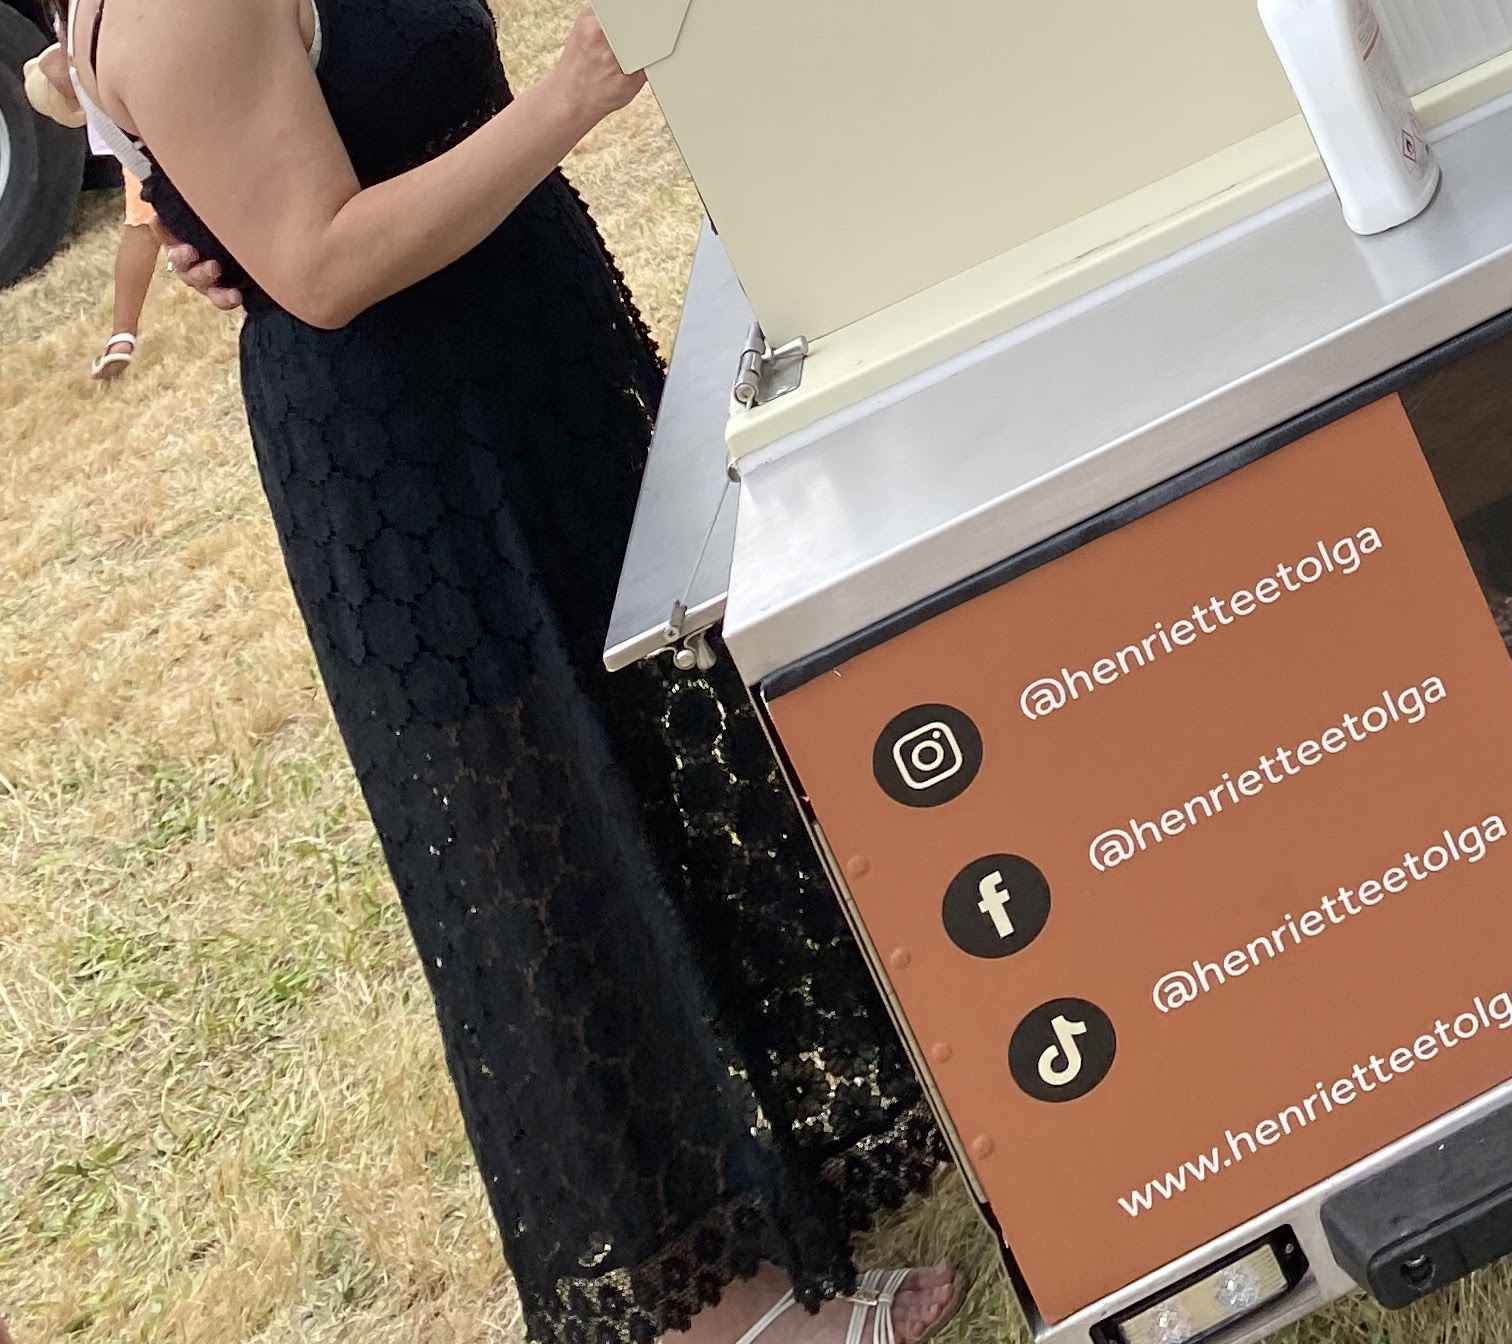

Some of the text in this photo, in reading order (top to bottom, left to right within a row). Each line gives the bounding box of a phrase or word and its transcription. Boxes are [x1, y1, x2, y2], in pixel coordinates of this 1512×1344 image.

[1019, 522, 1384, 721] @henrietteetolga
[1088, 672, 1448, 873] @henrietteetolga
[1152, 813, 1508, 1015] @henrietteetolga
